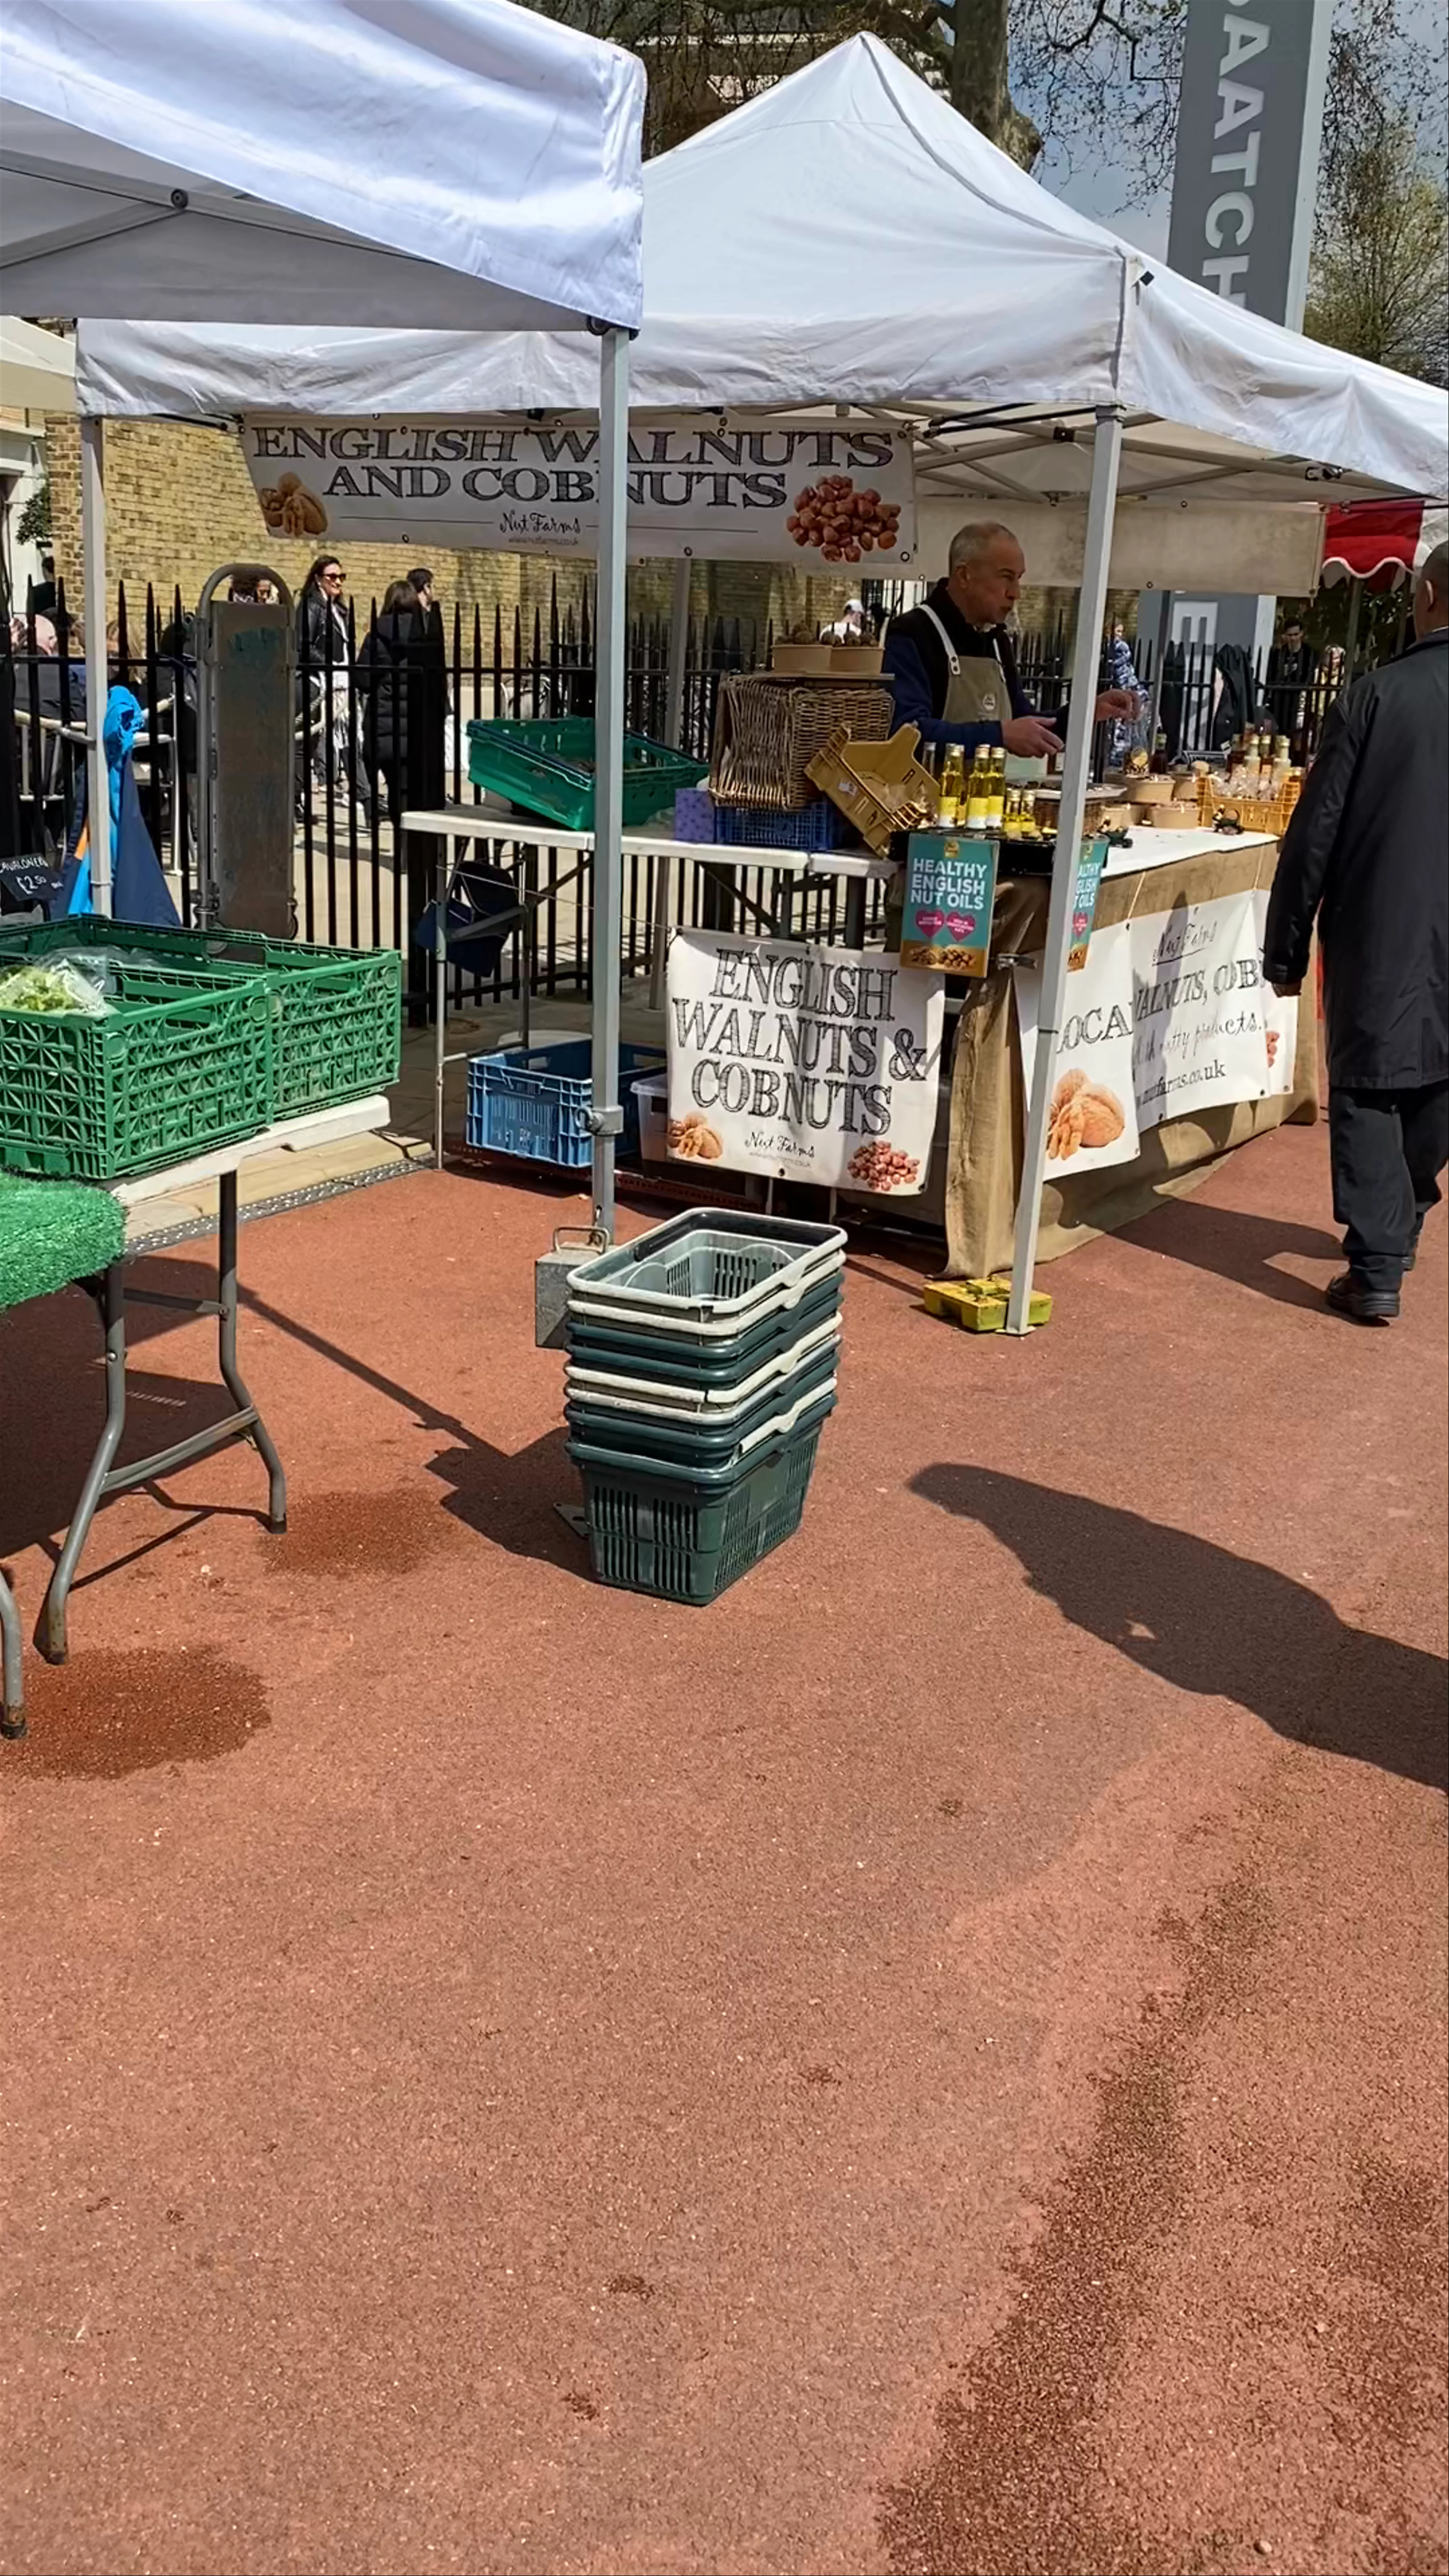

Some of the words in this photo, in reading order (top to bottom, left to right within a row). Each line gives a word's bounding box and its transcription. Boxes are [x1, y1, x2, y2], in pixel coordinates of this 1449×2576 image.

[1203, 0, 1271, 311] AATCH
[252, 427, 518, 462] ENGLISH
[323, 466, 451, 498] AND
[499, 509, 529, 534] Nut
[529, 512, 581, 534] Farms
[913, 858, 988, 879] HEALTHY
[1078, 862, 1101, 878] ALTHY
[911, 874, 986, 896] ENGLISH
[911, 889, 943, 906] NUT
[948, 893, 984, 910] OILS
[709, 947, 898, 1021] ENGLISH
[1056, 1003, 1133, 1055] OCA
[1214, 958, 1264, 998] COB
[672, 997, 878, 1078] WALNUTS
[888, 1028, 927, 1081] &
[691, 1058, 892, 1136] COBNUTS
[744, 1131, 774, 1148] Nut
[777, 1135, 815, 1158] Farms
